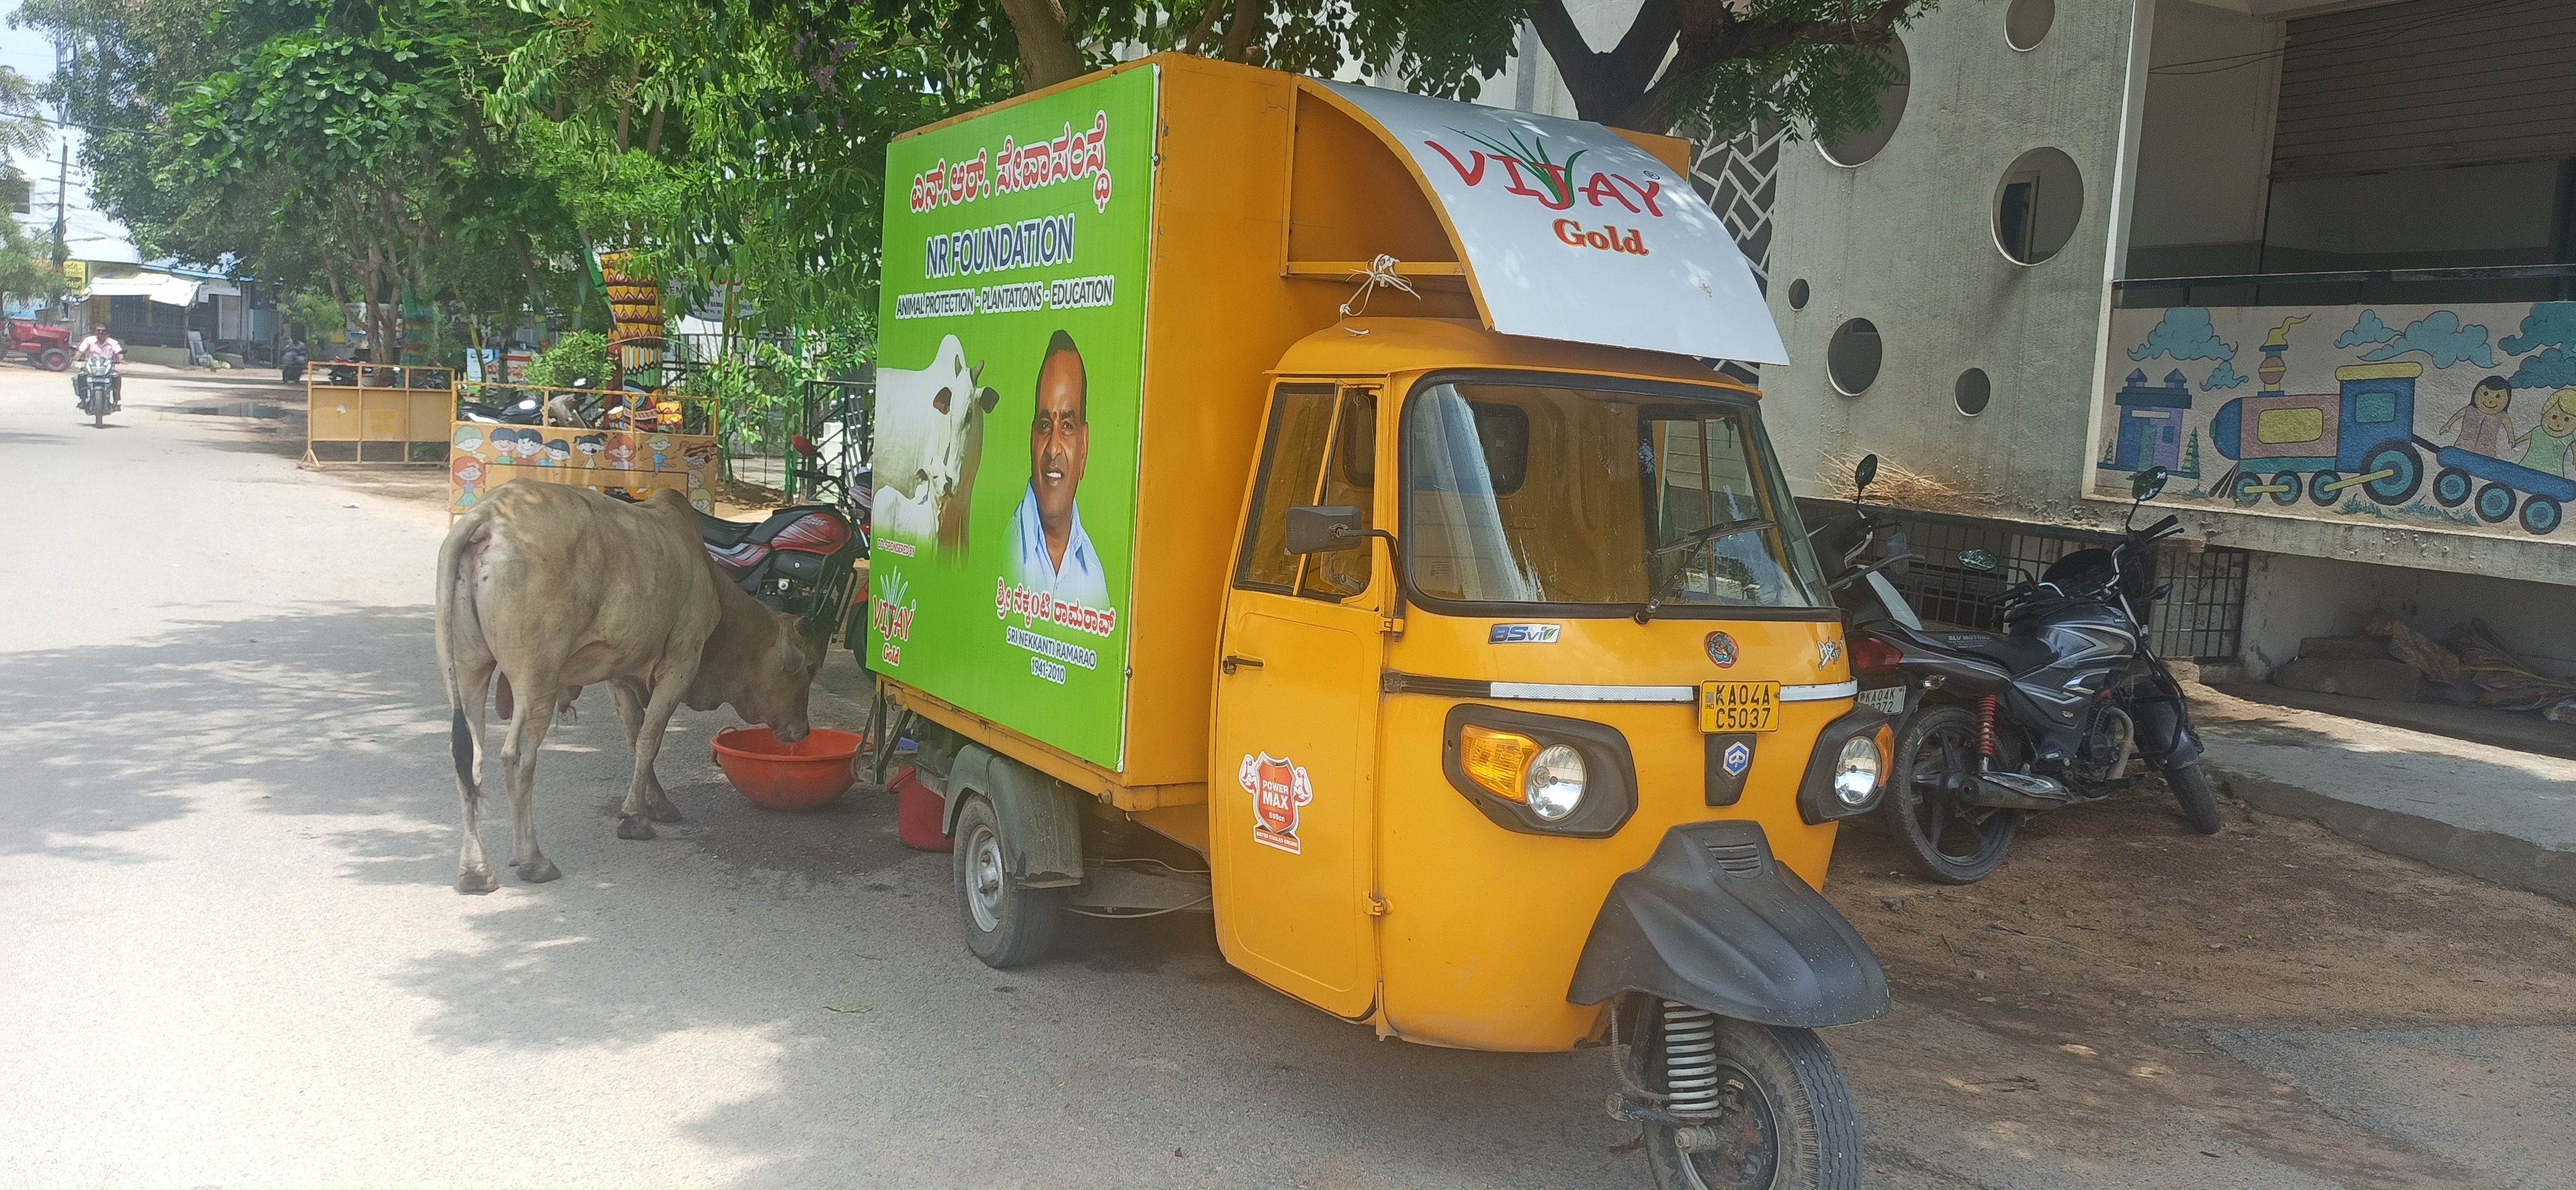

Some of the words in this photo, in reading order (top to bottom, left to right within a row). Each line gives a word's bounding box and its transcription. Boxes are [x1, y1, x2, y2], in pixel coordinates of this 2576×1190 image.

[1423, 140, 1664, 217] VIJAY
[926, 237, 947, 276] NR
[951, 217, 1074, 273] FOUNDATION
[1552, 218, 1649, 256] Gold
[896, 297, 924, 317] ANIMAL
[925, 292, 974, 315] PROTECTION
[982, 285, 1042, 310] PLANTATIONS
[1051, 279, 1113, 306] EDUCATION
[873, 596, 914, 640] VIJAY
[997, 578, 1011, 617] ಶ್ರೀ
[1014, 585, 1050, 626] ನೆಕ್ಕಂಟಿ
[1053, 600, 1115, 635] ರಾಮರಾವ್
[883, 644, 900, 665] Gold
[1007, 627, 1018, 643] SRI
[1019, 631, 1055, 656] NEKKANTI
[1056, 641, 1096, 668] RAMARAO
[1032, 658, 1065, 683] 1941-2010
[1715, 684, 1770, 706] KA04A
[1865, 688, 1896, 703] KA04K
[1715, 707, 1771, 729] C5037
[1262, 779, 1289, 795] POWER
[1262, 789, 1289, 811] MAX
